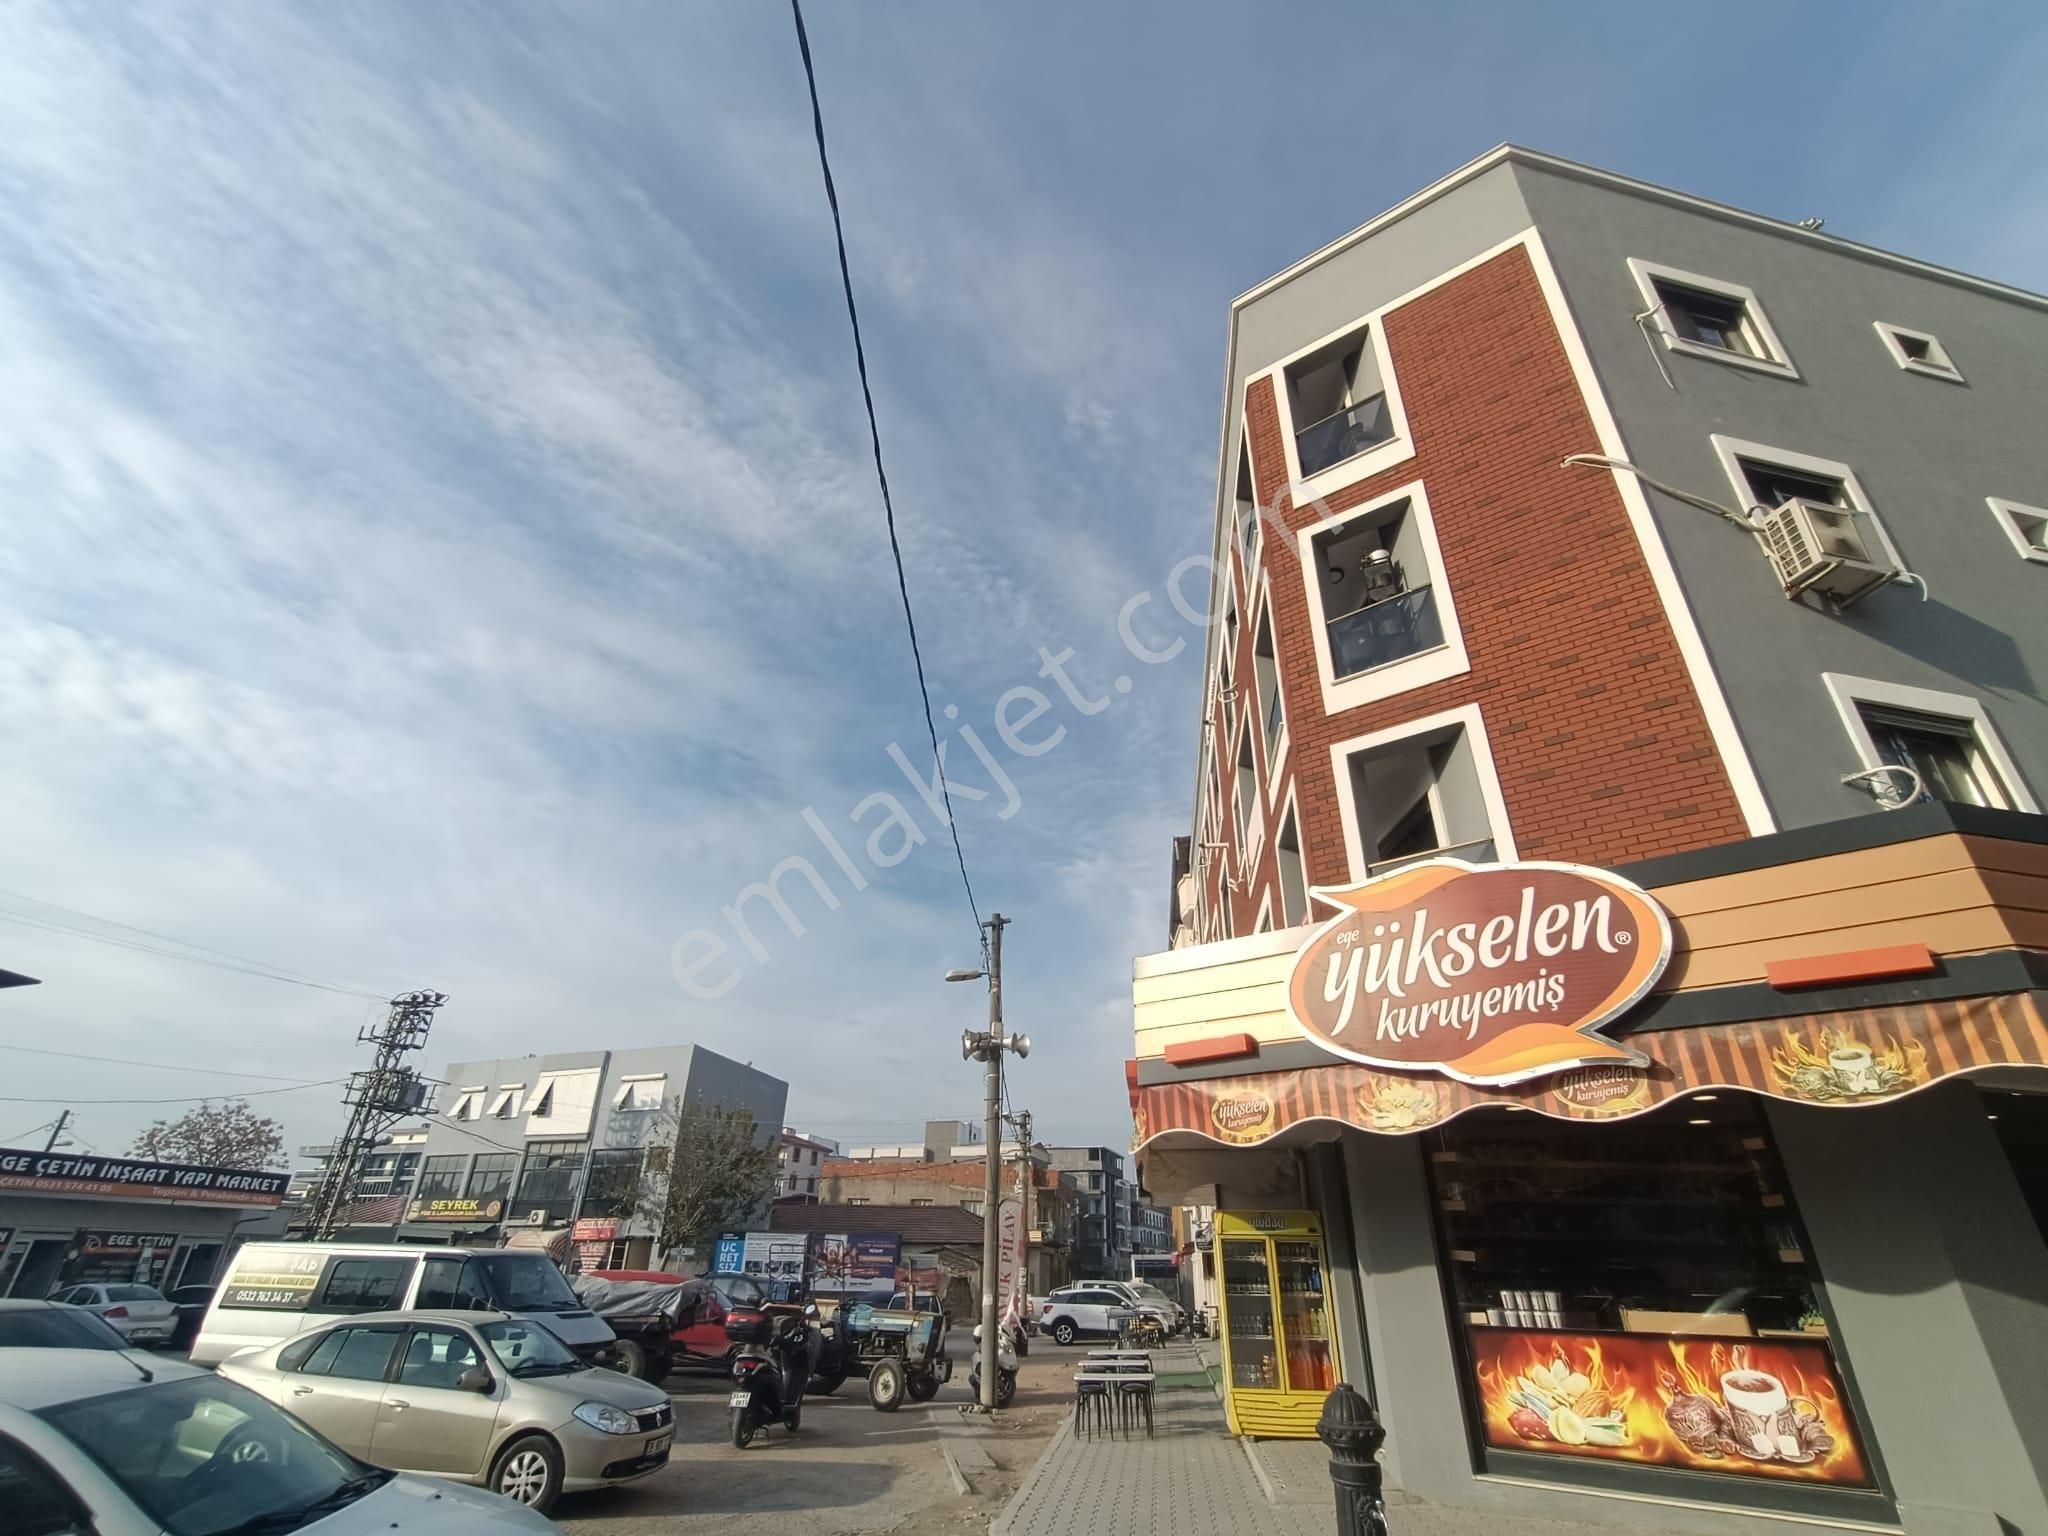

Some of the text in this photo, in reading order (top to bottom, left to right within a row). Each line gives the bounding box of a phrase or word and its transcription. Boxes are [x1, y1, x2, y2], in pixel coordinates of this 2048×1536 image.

[1337, 929, 1359, 950] ege
[1324, 886, 1618, 1037] yükselen
[1376, 968, 1565, 1042] kuruyemiş
[1564, 1065, 1634, 1099] yükselen
[1577, 1083, 1628, 1101] kuruyemiş
[1220, 1096, 1266, 1125] yükselen
[0, 1155, 281, 1192] GE ÇETİN İNŞAAT YAPI MARKET
[152, 1186, 188, 1197] Toptan
[200, 1189, 250, 1202] Perakende
[430, 1200, 480, 1210] SEYREK
[107, 1235, 135, 1246] EGE
[720, 1252, 739, 1262] RET
